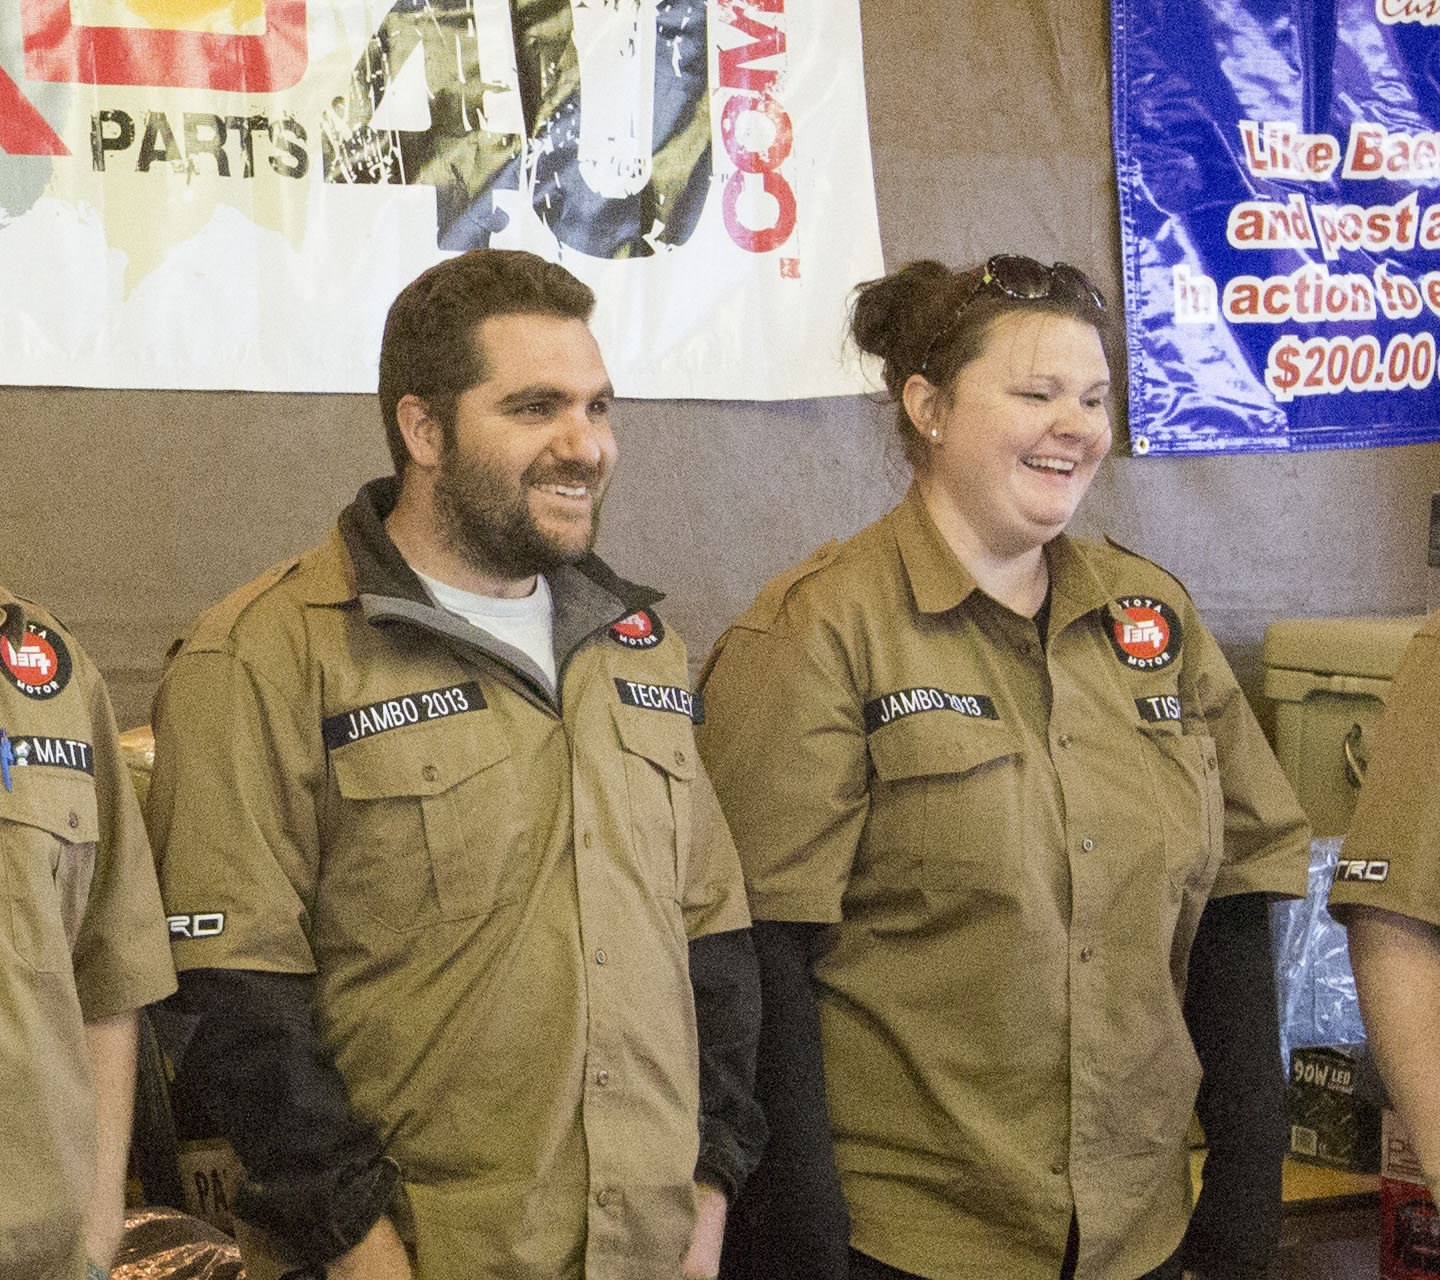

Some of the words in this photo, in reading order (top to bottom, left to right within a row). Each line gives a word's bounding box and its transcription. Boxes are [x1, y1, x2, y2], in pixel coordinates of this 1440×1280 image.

[88, 109, 310, 179] PARTS
[1244, 127, 1334, 172] Like
[1234, 202, 1312, 242] and
[1319, 205, 1414, 252] post
[1179, 273, 1212, 316] in
[1229, 273, 1371, 315] action
[1381, 275, 1419, 311] to
[1272, 340, 1432, 393] $200.00
[1123, 598, 1162, 613] YOTA
[1128, 651, 1171, 668] MOTOR
[16, 678, 60, 695] MOTOR
[347, 696, 419, 740] JAMBO
[421, 687, 469, 720] 2013
[880, 687, 945, 723] JAMBO
[944, 693, 982, 717] 2013
[32, 737, 88, 769] MATT
[166, 912, 224, 937] RD
[1293, 1060, 1329, 1089] 90W
